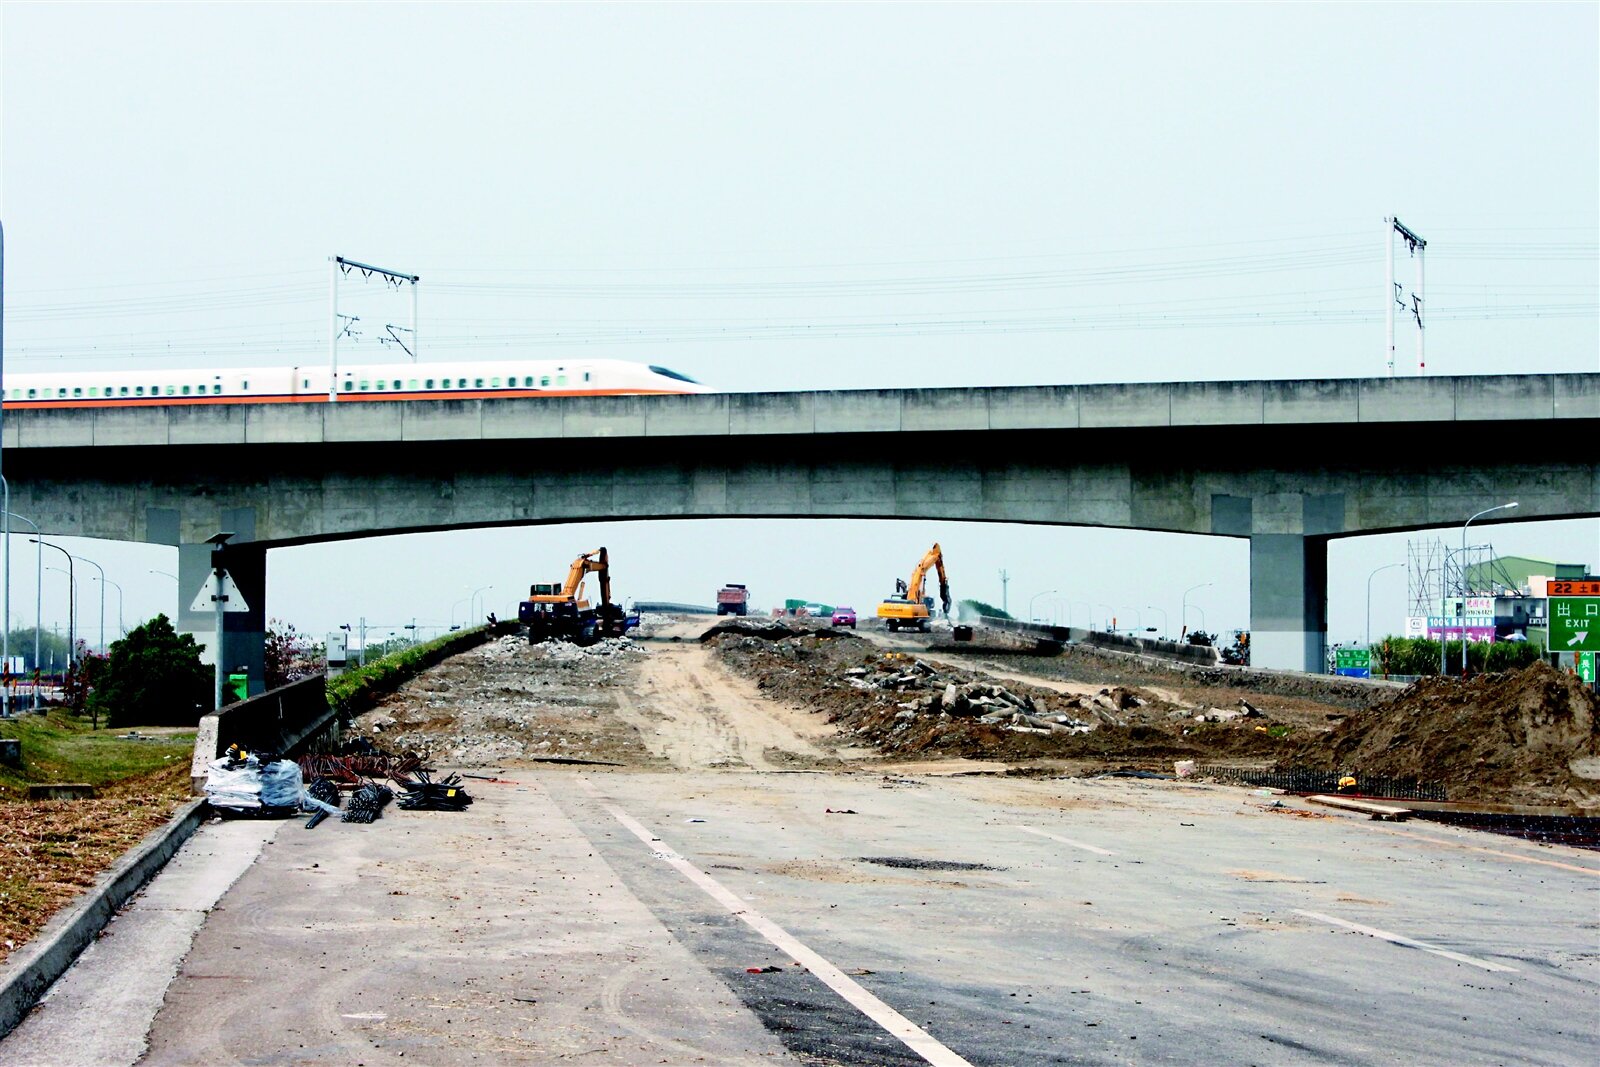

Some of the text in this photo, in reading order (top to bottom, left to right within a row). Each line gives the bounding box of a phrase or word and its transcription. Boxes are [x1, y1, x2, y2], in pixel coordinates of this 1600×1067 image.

[1555, 584, 1572, 593] 22
[1558, 603, 1598, 617] 出口
[1566, 619, 1590, 628] EXIT
